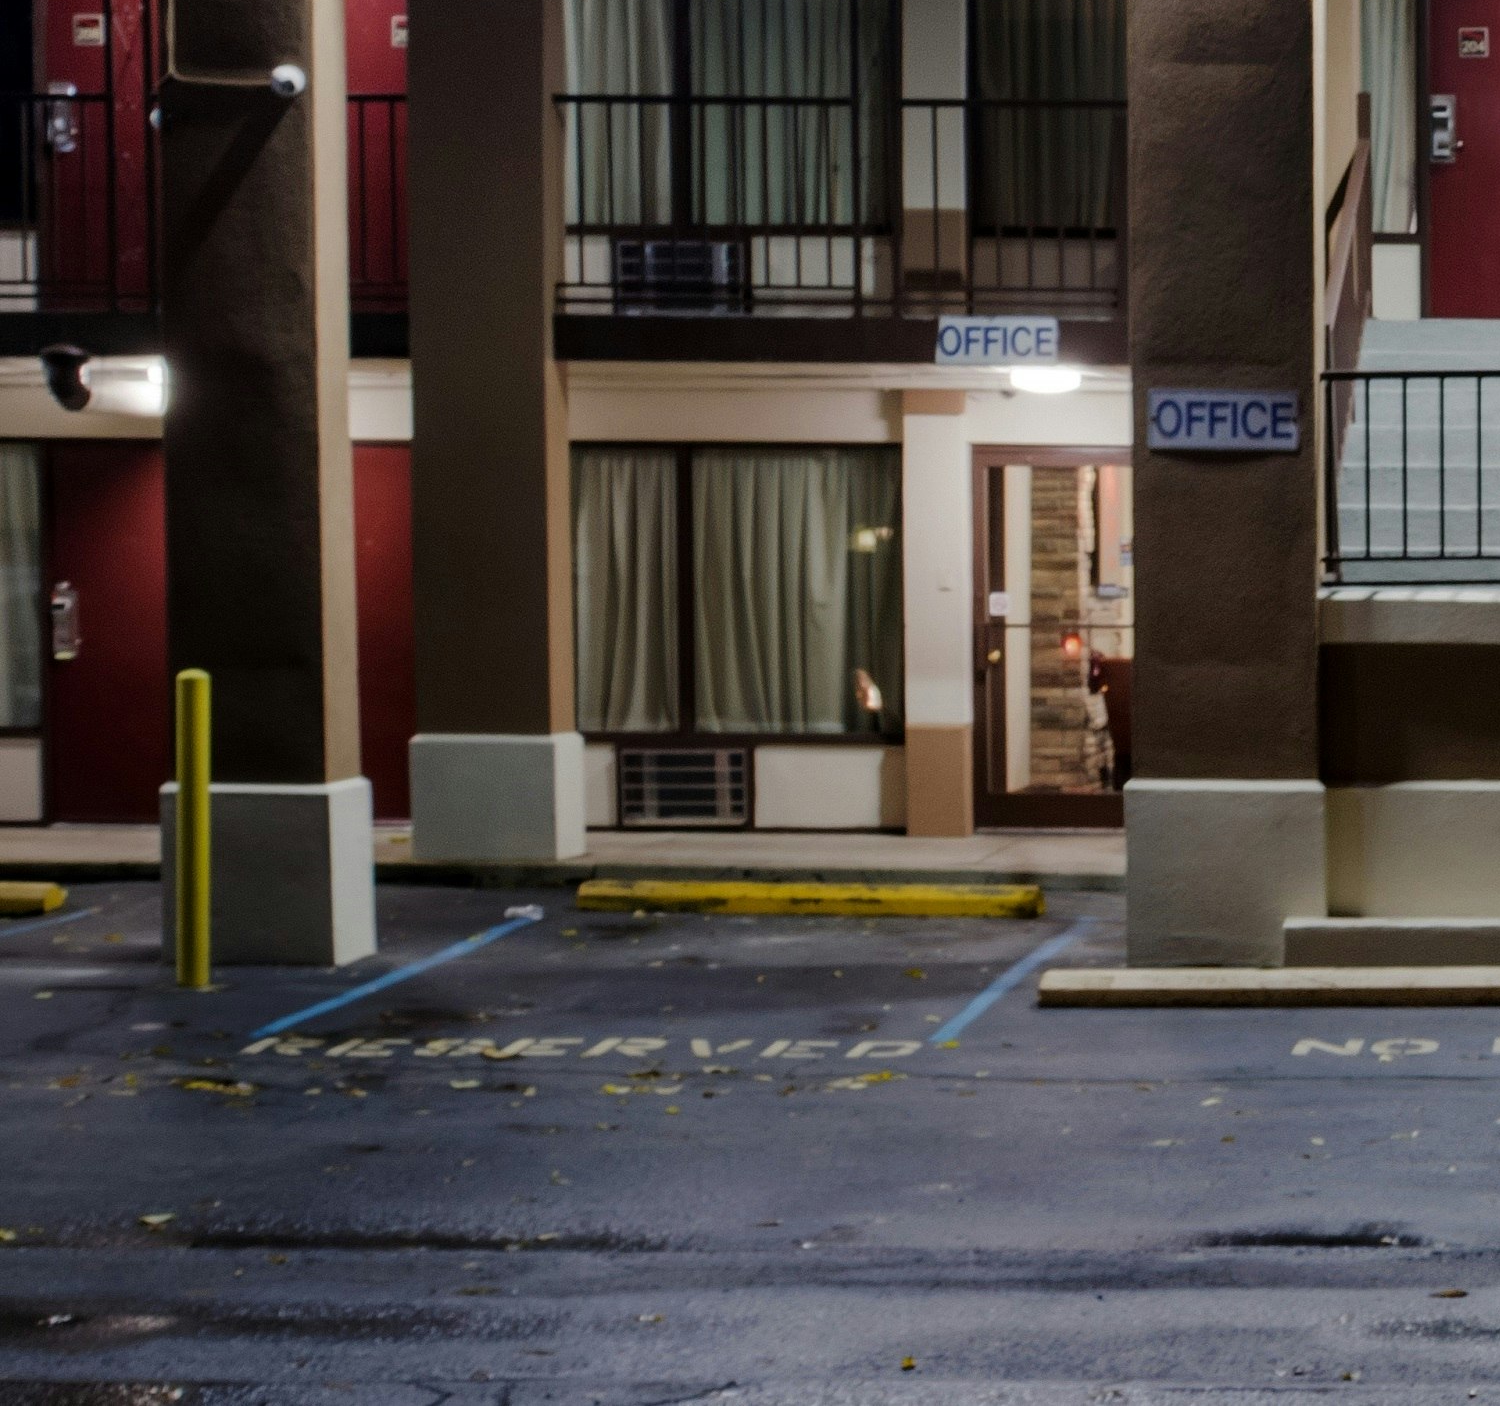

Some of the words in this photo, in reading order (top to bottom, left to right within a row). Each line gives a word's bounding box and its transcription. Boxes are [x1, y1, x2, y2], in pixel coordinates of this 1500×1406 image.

[937, 325, 1054, 357] OFFICE
[1154, 398, 1294, 440] OFFICE
[239, 1037, 923, 1059] RESERVED
[1291, 1036, 1439, 1057] NO
